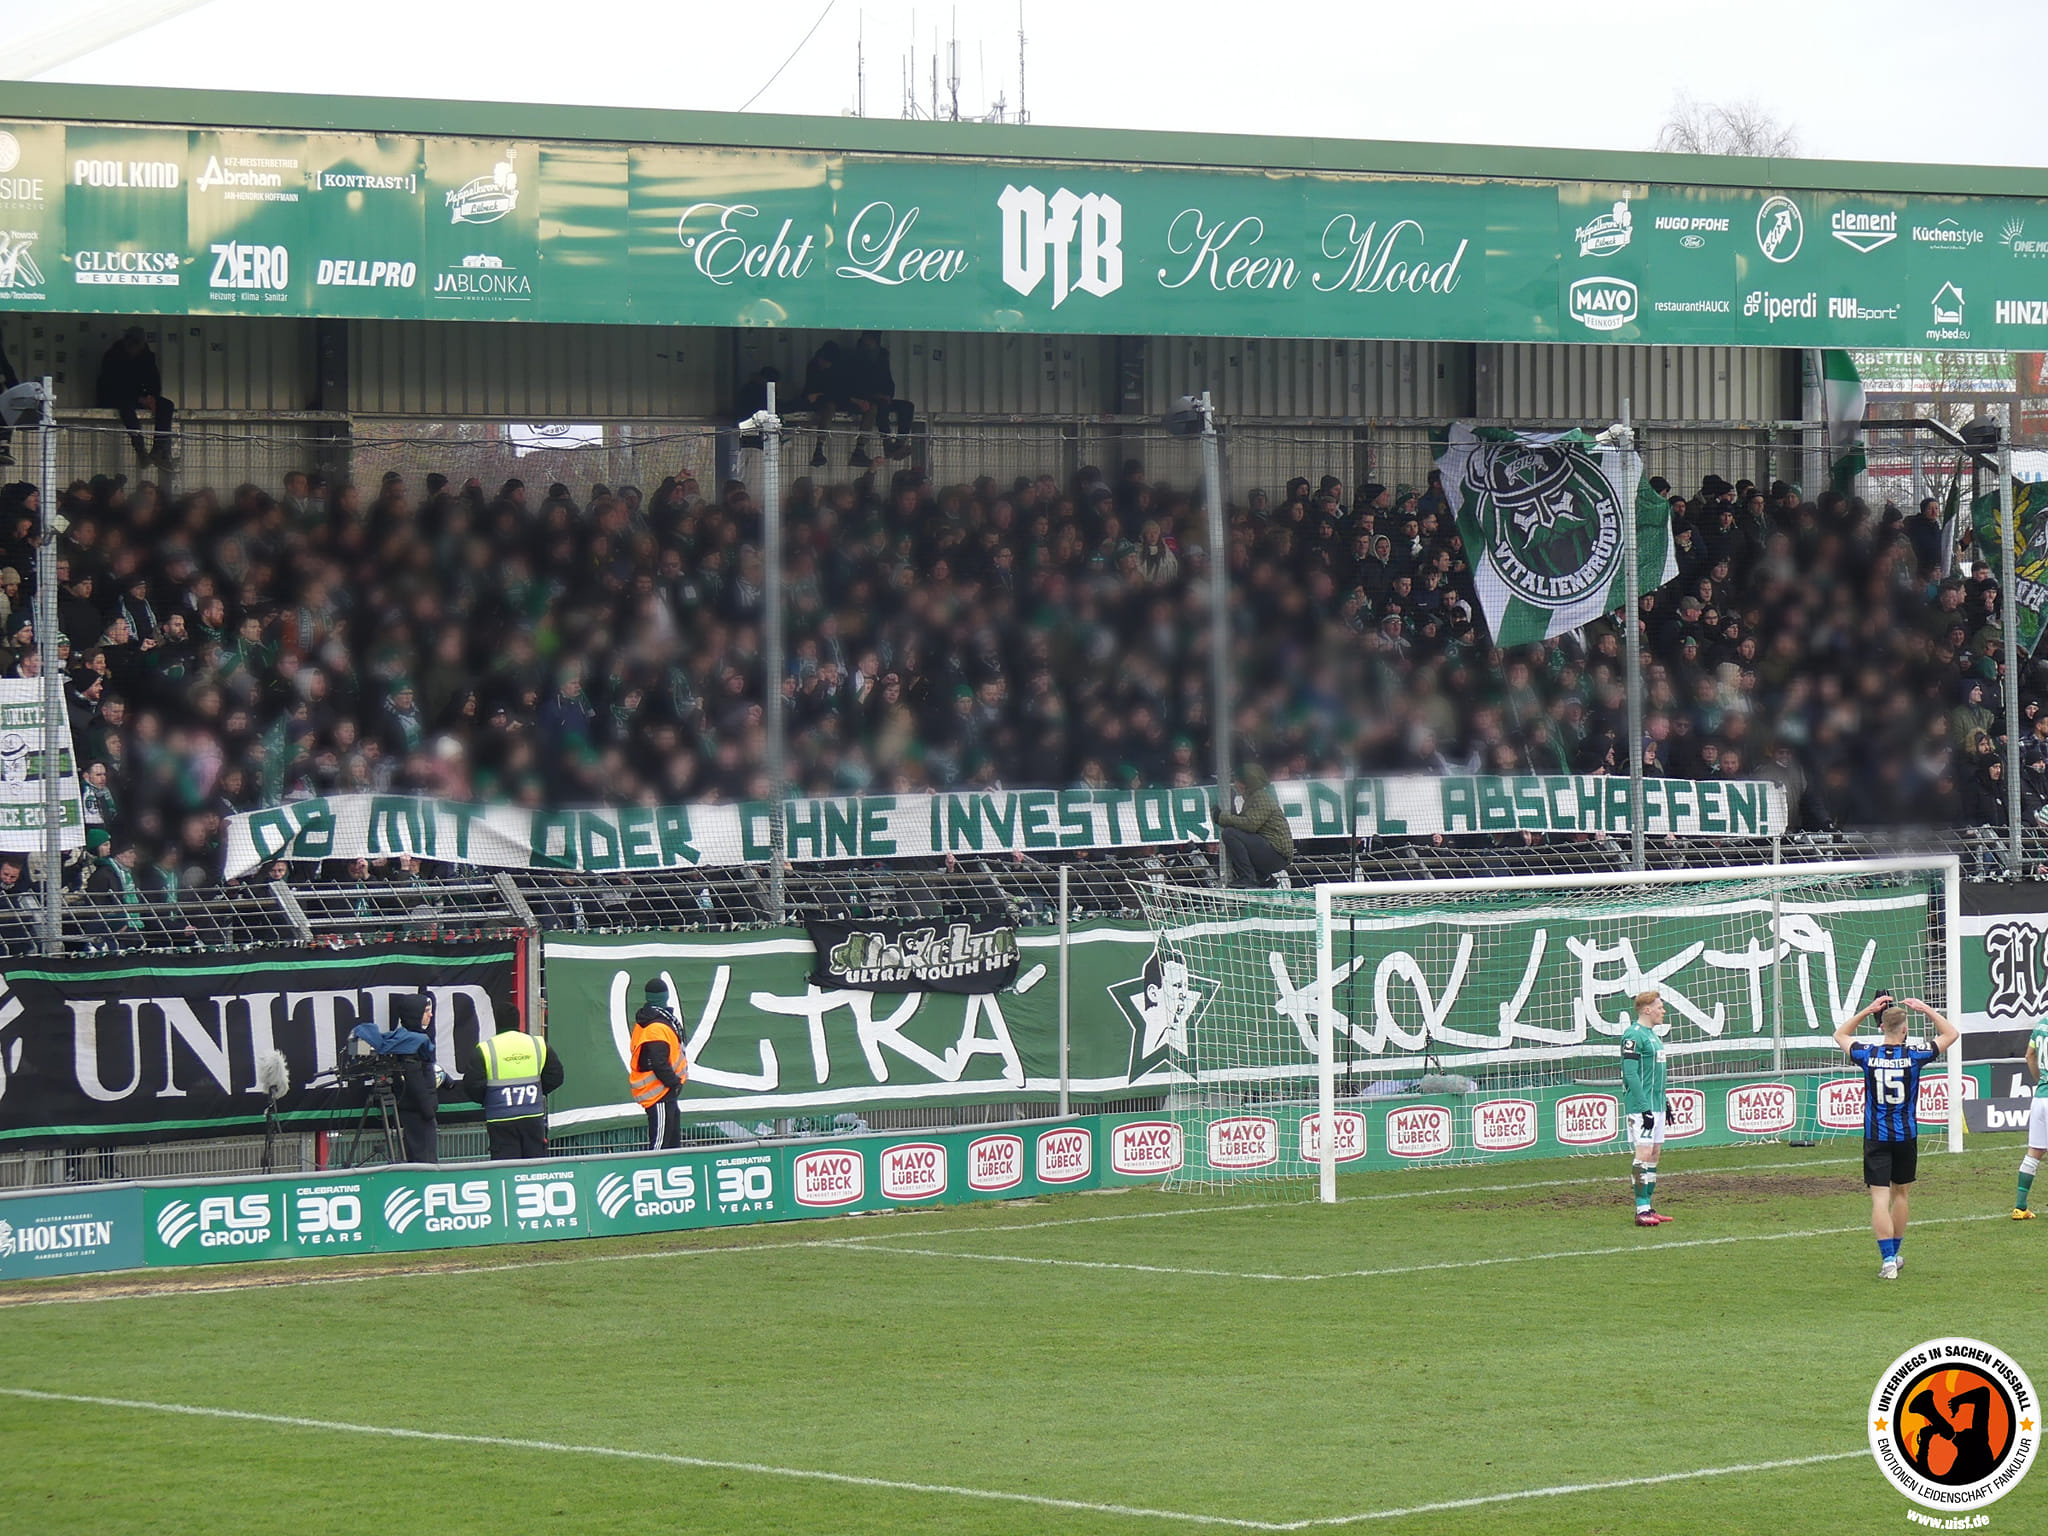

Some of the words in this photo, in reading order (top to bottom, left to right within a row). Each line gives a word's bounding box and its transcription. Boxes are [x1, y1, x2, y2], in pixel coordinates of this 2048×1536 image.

[196, 155, 282, 192] Abraham
[1655, 216, 1689, 231] HUGO
[1690, 217, 1730, 232] PFOHE
[1831, 209, 1898, 232] clement
[1912, 226, 1984, 246] Küchenstyle
[678, 202, 814, 287] Echt
[835, 200, 969, 286] Leev
[1156, 208, 1302, 292] Keen
[1311, 213, 1470, 294] Mood
[75, 251, 165, 272] GLÜCKS
[93, 274, 164, 284] EVENTS
[316, 259, 417, 288] DELLPRO
[433, 273, 532, 295] JABLONKA
[209, 291, 236, 302] Heizung
[240, 292, 260, 301] Klima
[264, 292, 289, 303] Sanitär
[1576, 289, 1632, 312] MAYO
[1763, 291, 1818, 324] iperdi
[1586, 316, 1621, 328] FEINKOST
[1926, 328, 1970, 342] my-bed.eu
[1508, 454, 1535, 472] 1919
[1494, 497, 1618, 598] VITALIENBRÜDER
[248, 796, 337, 862] OB
[367, 796, 487, 859] MIT
[529, 803, 701, 871] ODER
[738, 796, 898, 862] OHNE
[1867, 1056, 1912, 1069] KARBSTEIN
[501, 1084, 538, 1107] 179
[1831, 1087, 1865, 1103] MAY
[1874, 1068, 1906, 1105] 15
[1738, 1090, 1785, 1108] MAYO
[1920, 1098, 1949, 1111] LÜBE
[1483, 1106, 1528, 1124] MAYO
[1565, 1101, 1608, 1118] MAYO
[1738, 1107, 1785, 1121] LÜBECK
[1310, 1118, 1356, 1136] MYO
[1396, 1112, 1441, 1130] MAYO
[1565, 1117, 1608, 1133] LÜBECK
[1123, 1129, 1171, 1148] MAYO
[1218, 1123, 1266, 1143] MAYO
[1397, 1129, 1441, 1145] LÜBECK
[1483, 1123, 1527, 1138] LÜBECK
[977, 1142, 1014, 1161] MAYO
[1045, 1135, 1083, 1155] MAYO
[1124, 1145, 1171, 1162] LÜBECK
[1219, 1140, 1266, 1156] LÜBECK
[715, 1155, 772, 1167] CELEBRATING
[805, 1157, 852, 1177] MAYO
[892, 1151, 936, 1171] MAYO
[977, 1159, 1014, 1177] LÜBECK
[1045, 1151, 1083, 1169] LÜBECK
[514, 1170, 575, 1183] CELEBRATING
[632, 1165, 696, 1201] FLS
[717, 1166, 773, 1202] 30
[806, 1175, 853, 1193] LÜBECK
[892, 1168, 936, 1186] LÜBECK
[296, 1184, 361, 1195] CELEBRATING
[423, 1180, 492, 1217] FLS
[515, 1181, 577, 1219] 30
[634, 1198, 697, 1218] GROUP
[719, 1200, 775, 1214] YEARS
[199, 1194, 272, 1231] FLS
[297, 1195, 363, 1233] 30
[425, 1214, 493, 1233] GROUP
[517, 1217, 579, 1230] YEARS
[17, 1221, 113, 1253] HOLSTEN
[200, 1228, 271, 1248] GROUP
[298, 1231, 363, 1245] YEARS
